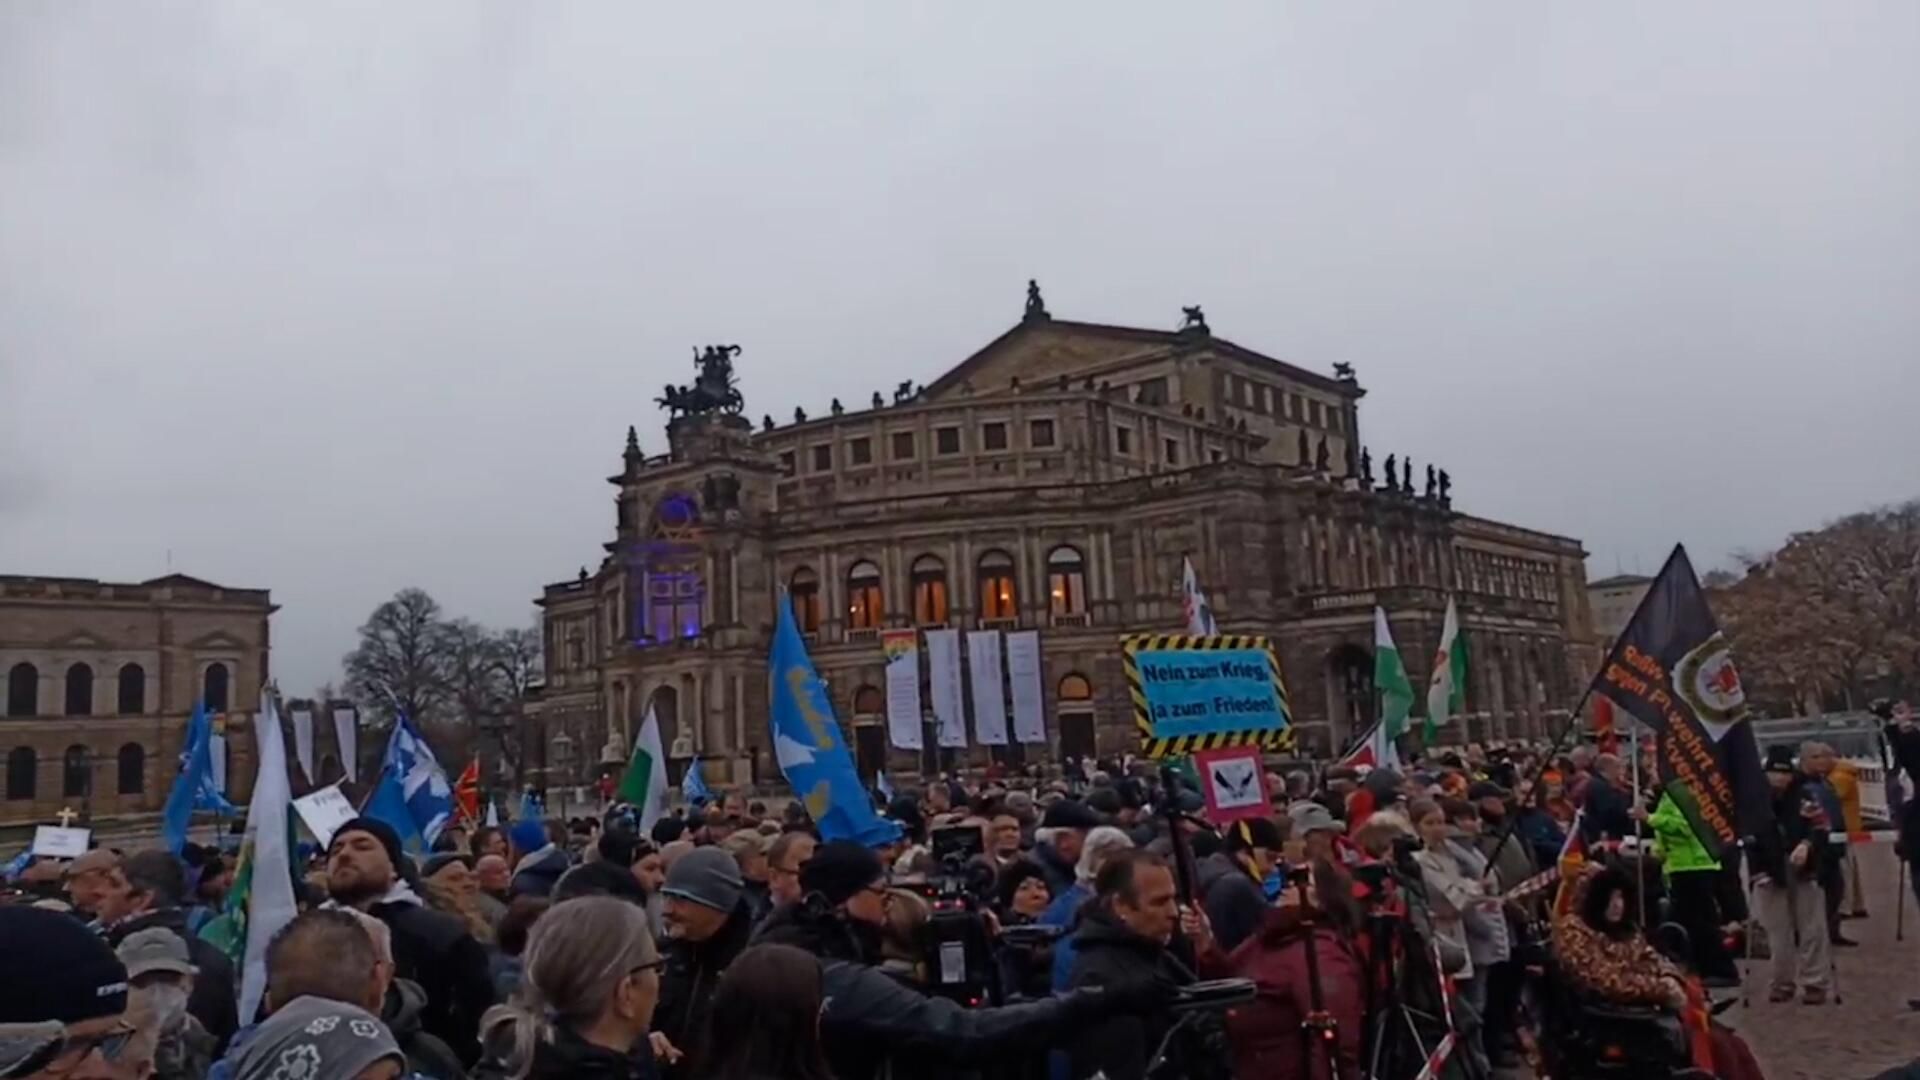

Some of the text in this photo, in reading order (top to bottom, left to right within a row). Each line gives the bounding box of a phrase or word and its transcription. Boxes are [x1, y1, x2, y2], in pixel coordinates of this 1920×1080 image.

[1143, 663, 1186, 682] Nein
[1188, 665, 1219, 680] zum
[1172, 702, 1207, 719] zum
[1213, 696, 1276, 715] Frieden!
[1669, 711, 1714, 770] wehrt
